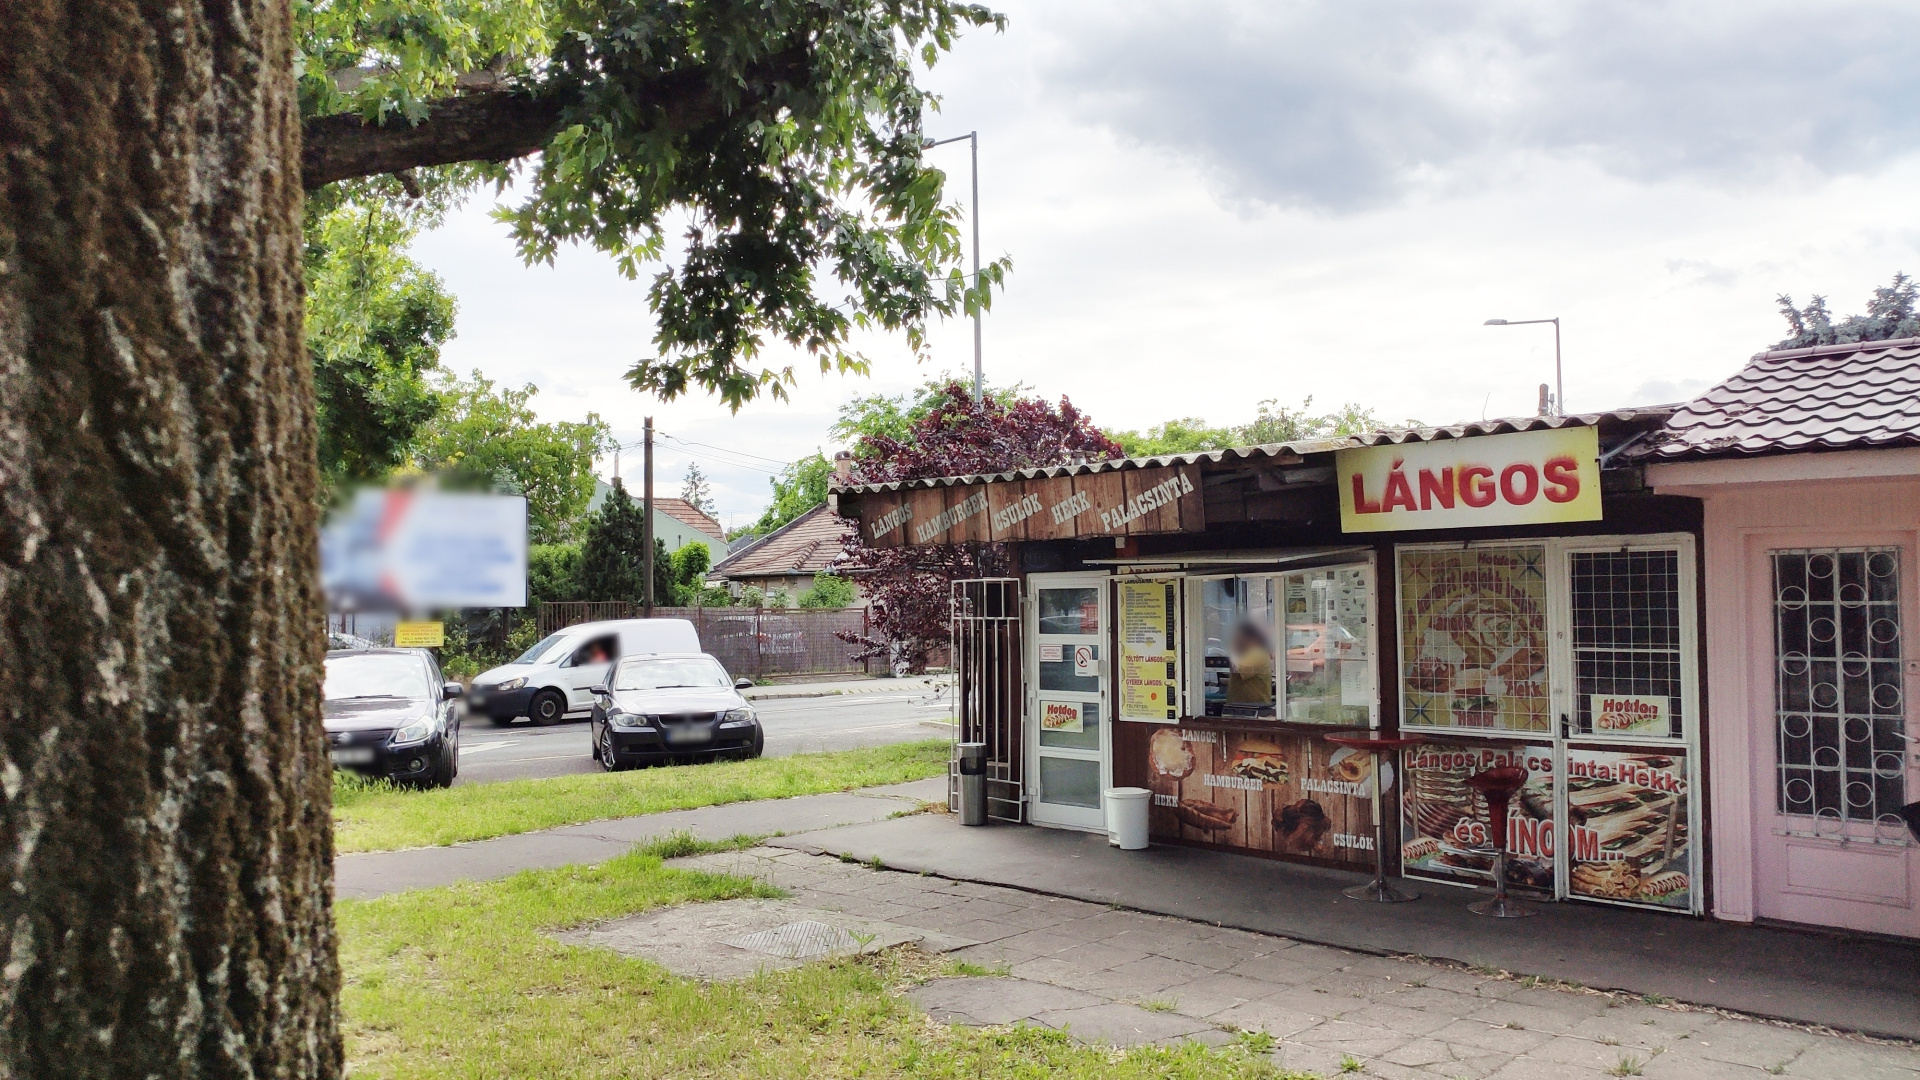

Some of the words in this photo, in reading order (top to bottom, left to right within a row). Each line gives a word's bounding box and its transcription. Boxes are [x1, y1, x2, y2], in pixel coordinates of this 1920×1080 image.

[1352, 455, 1580, 514] LÁNGOS
[870, 502, 913, 539] LÁNGOS
[916, 491, 989, 543] HAMBURGER
[994, 492, 1043, 532] CSÜLÖK
[1050, 490, 1092, 526] HEKK
[1101, 472, 1194, 533] PALACSINTA
[1047, 704, 1077, 720] Hotdog
[1603, 699, 1658, 719] Hotdog
[1406, 752, 1475, 771] Lángos
[1619, 763, 1680, 793] Hekk
[1203, 774, 1263, 791] HAMBURGER
[1300, 778, 1366, 796] PALACSINTA
[1154, 793, 1179, 807] HEKK
[1333, 832, 1374, 850] CSÜLÖK
[1456, 818, 1485, 844] és
